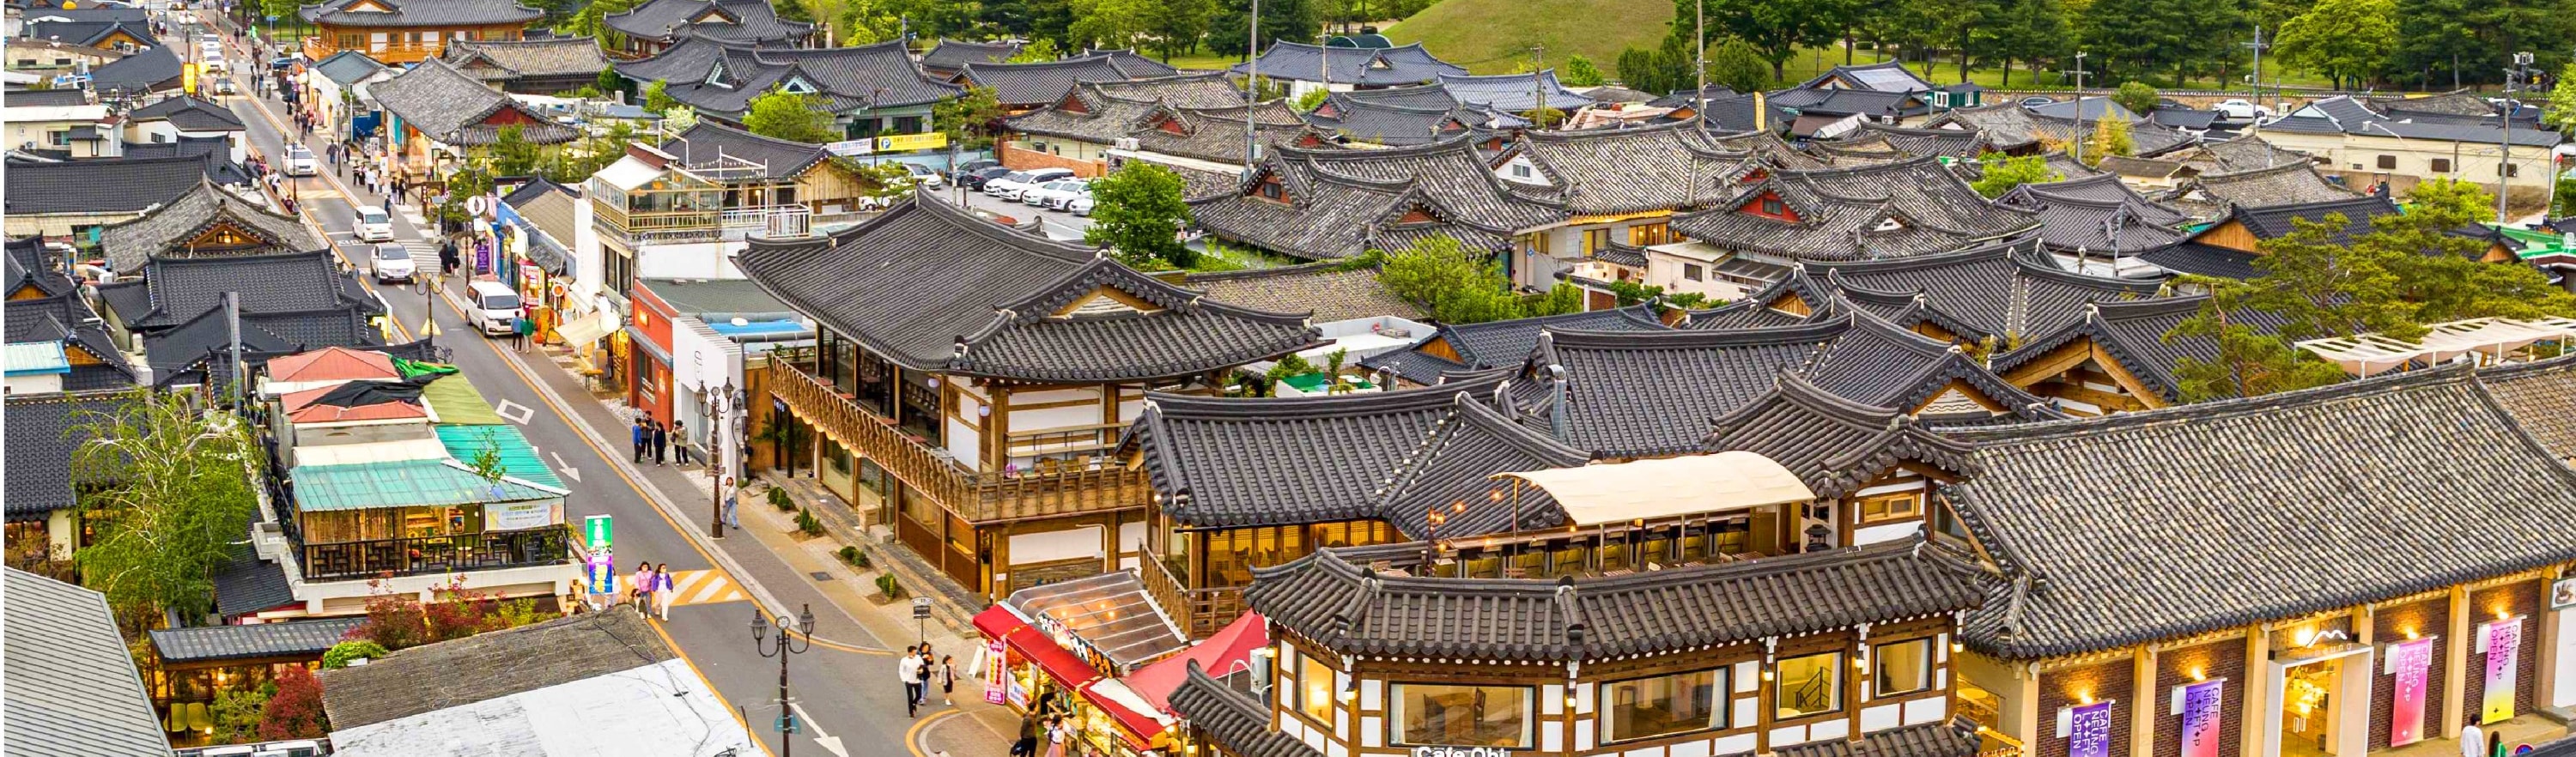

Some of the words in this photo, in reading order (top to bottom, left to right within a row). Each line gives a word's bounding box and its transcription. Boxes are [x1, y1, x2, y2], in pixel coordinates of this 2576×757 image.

[2489, 629, 2498, 660] OPEN
[2502, 626, 2511, 666] NEUNG
[2510, 625, 2518, 652] CAFE
[2397, 649, 2407, 681] OPEN
[2411, 646, 2421, 687] NEUNG
[2420, 645, 2428, 674] CAFE
[2185, 692, 2194, 726] OPEN
[2201, 689, 2211, 732] NEUNG
[2210, 687, 2220, 718] CAFE
[2073, 713, 2082, 749] OPEN
[2090, 711, 2099, 754] NEUNG
[2099, 709, 2108, 742] CAFE
